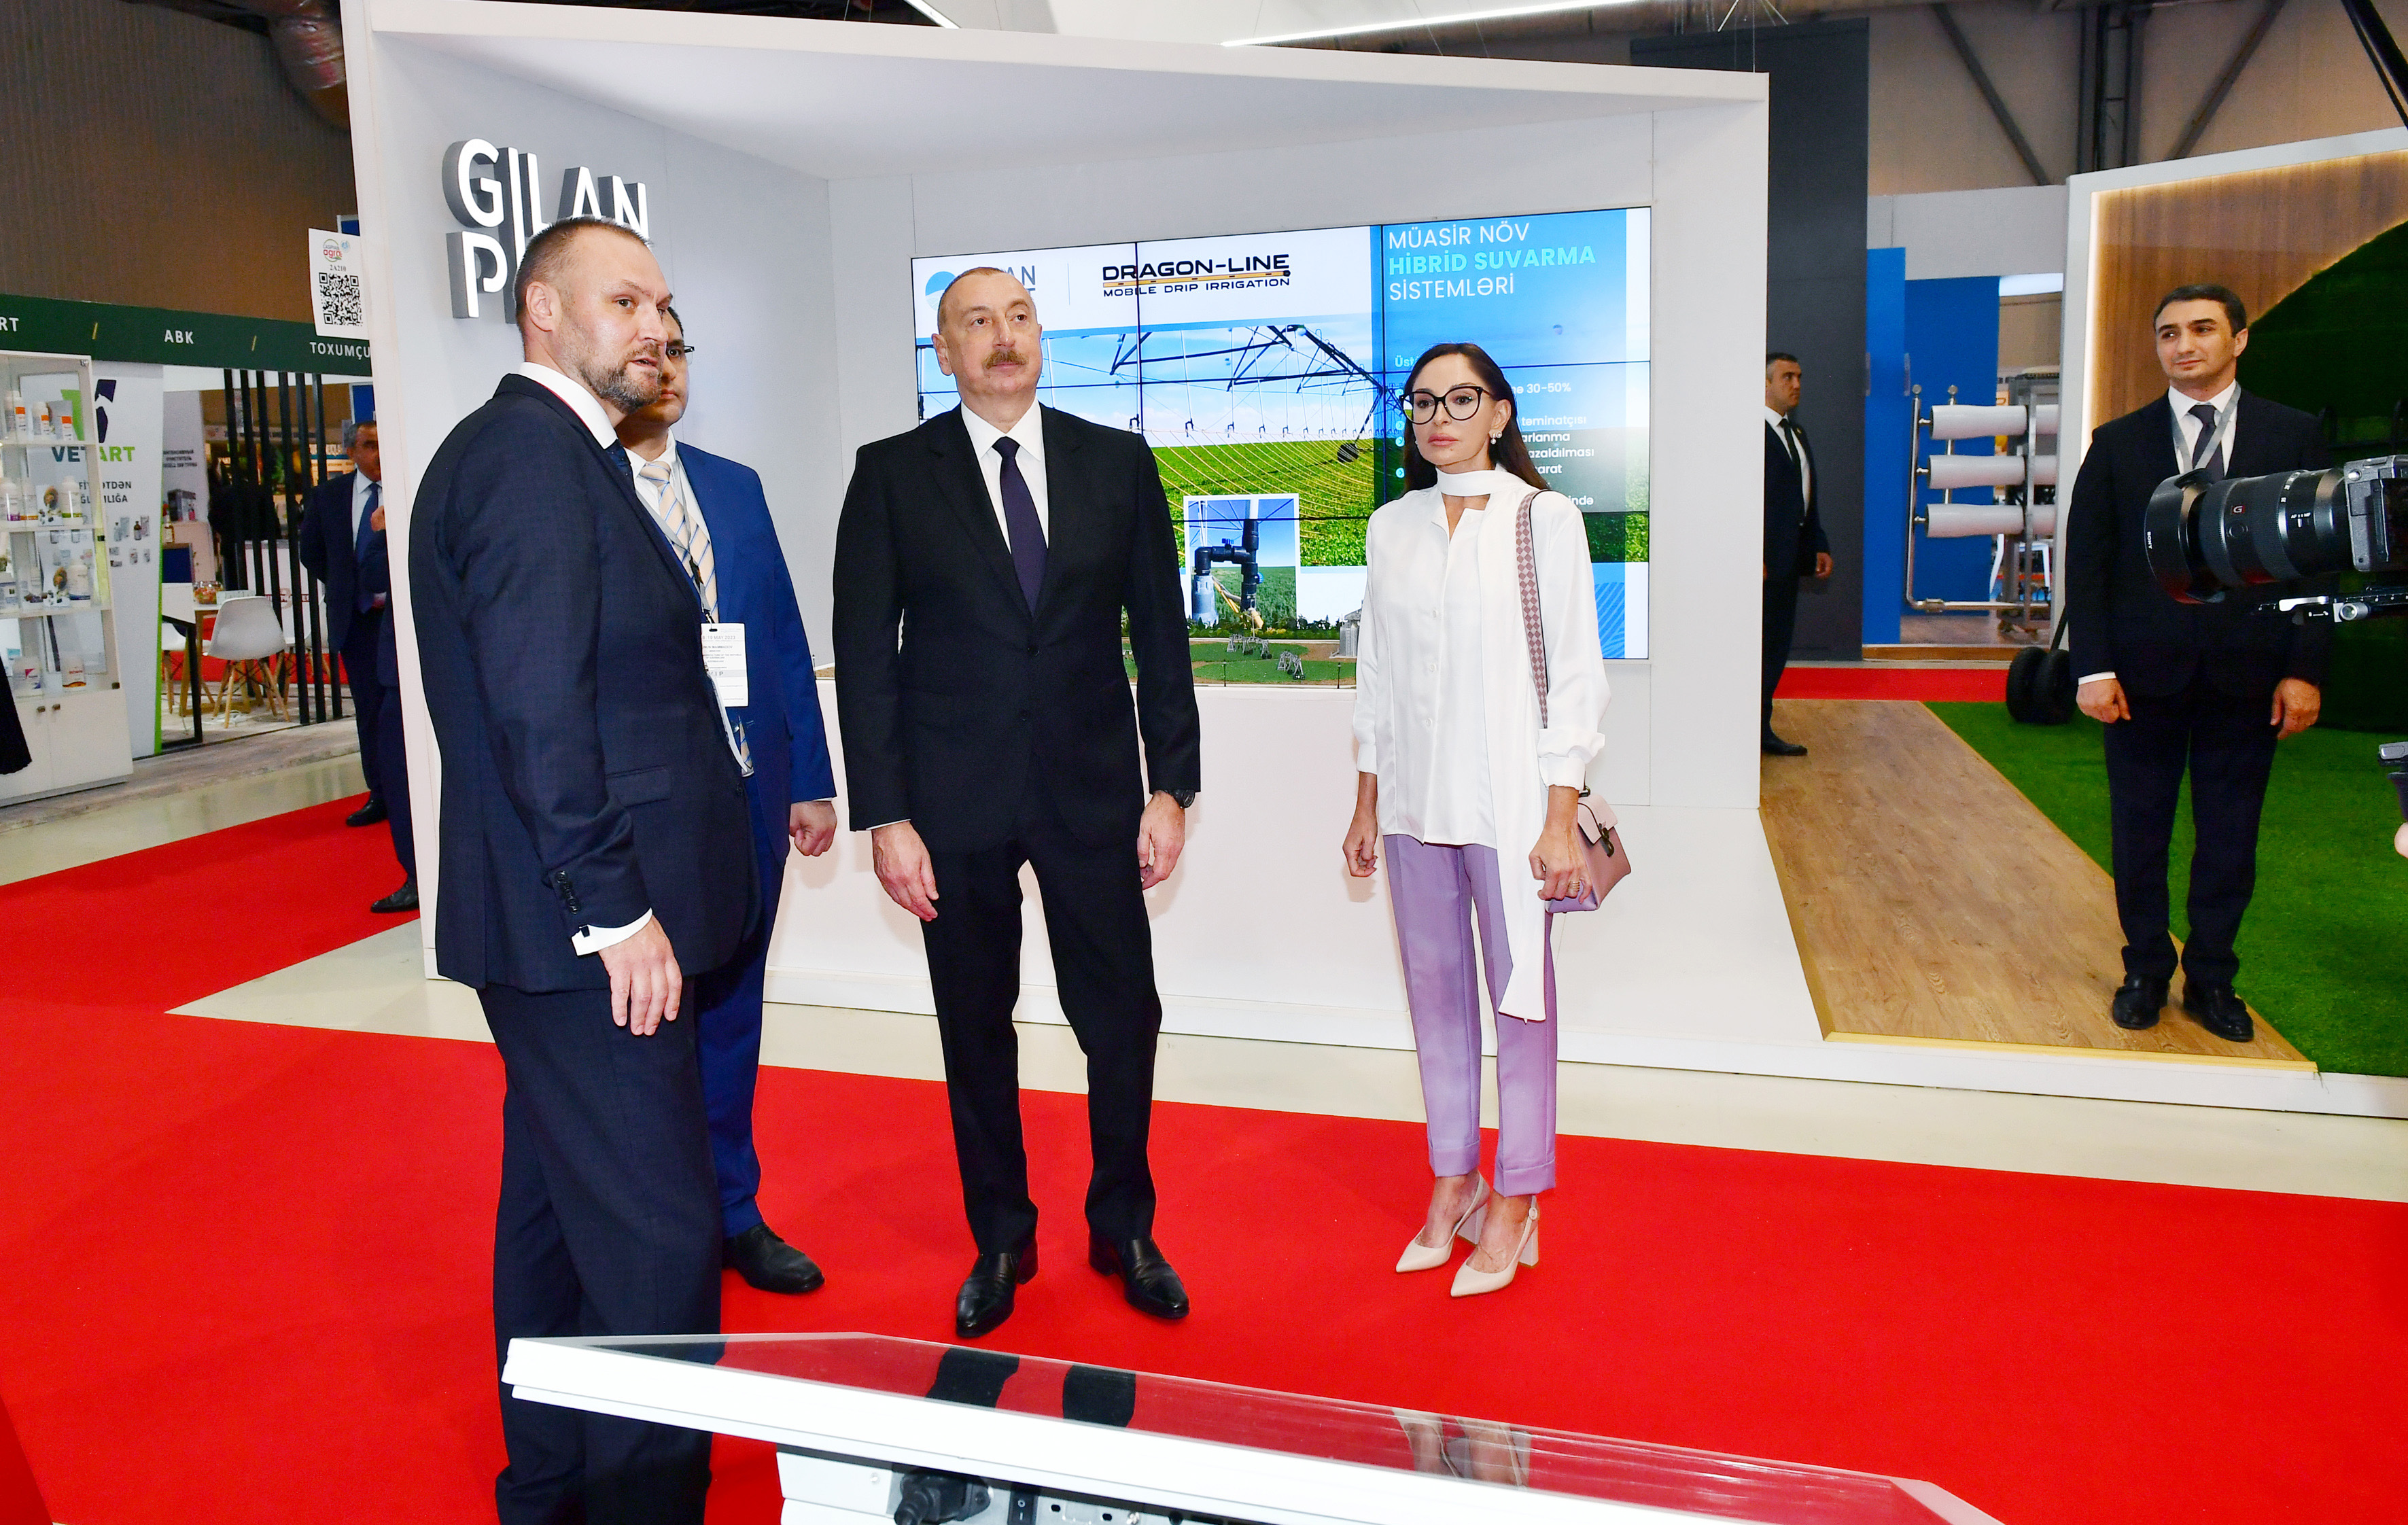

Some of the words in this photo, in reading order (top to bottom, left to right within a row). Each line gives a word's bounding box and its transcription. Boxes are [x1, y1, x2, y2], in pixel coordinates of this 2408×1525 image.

[1389, 224, 1471, 249] MÜASİR
[1480, 220, 1530, 243] NÖV
[1102, 254, 1289, 281] DRAGON-LINE
[1389, 250, 1467, 275] HİBRİD
[1474, 245, 1596, 270] SUVARMA
[1104, 286, 1157, 297] MOBILE
[1164, 283, 1199, 293] DRIP
[1206, 278, 1290, 290] IRRIGATION
[1390, 273, 1514, 300] SİSTEMLƏRİ
[164, 330, 194, 345] ABK
[1526, 383, 1571, 393] 30-50%
[1522, 415, 1586, 427] təminatçısı
[1522, 432, 1571, 442] arlanma
